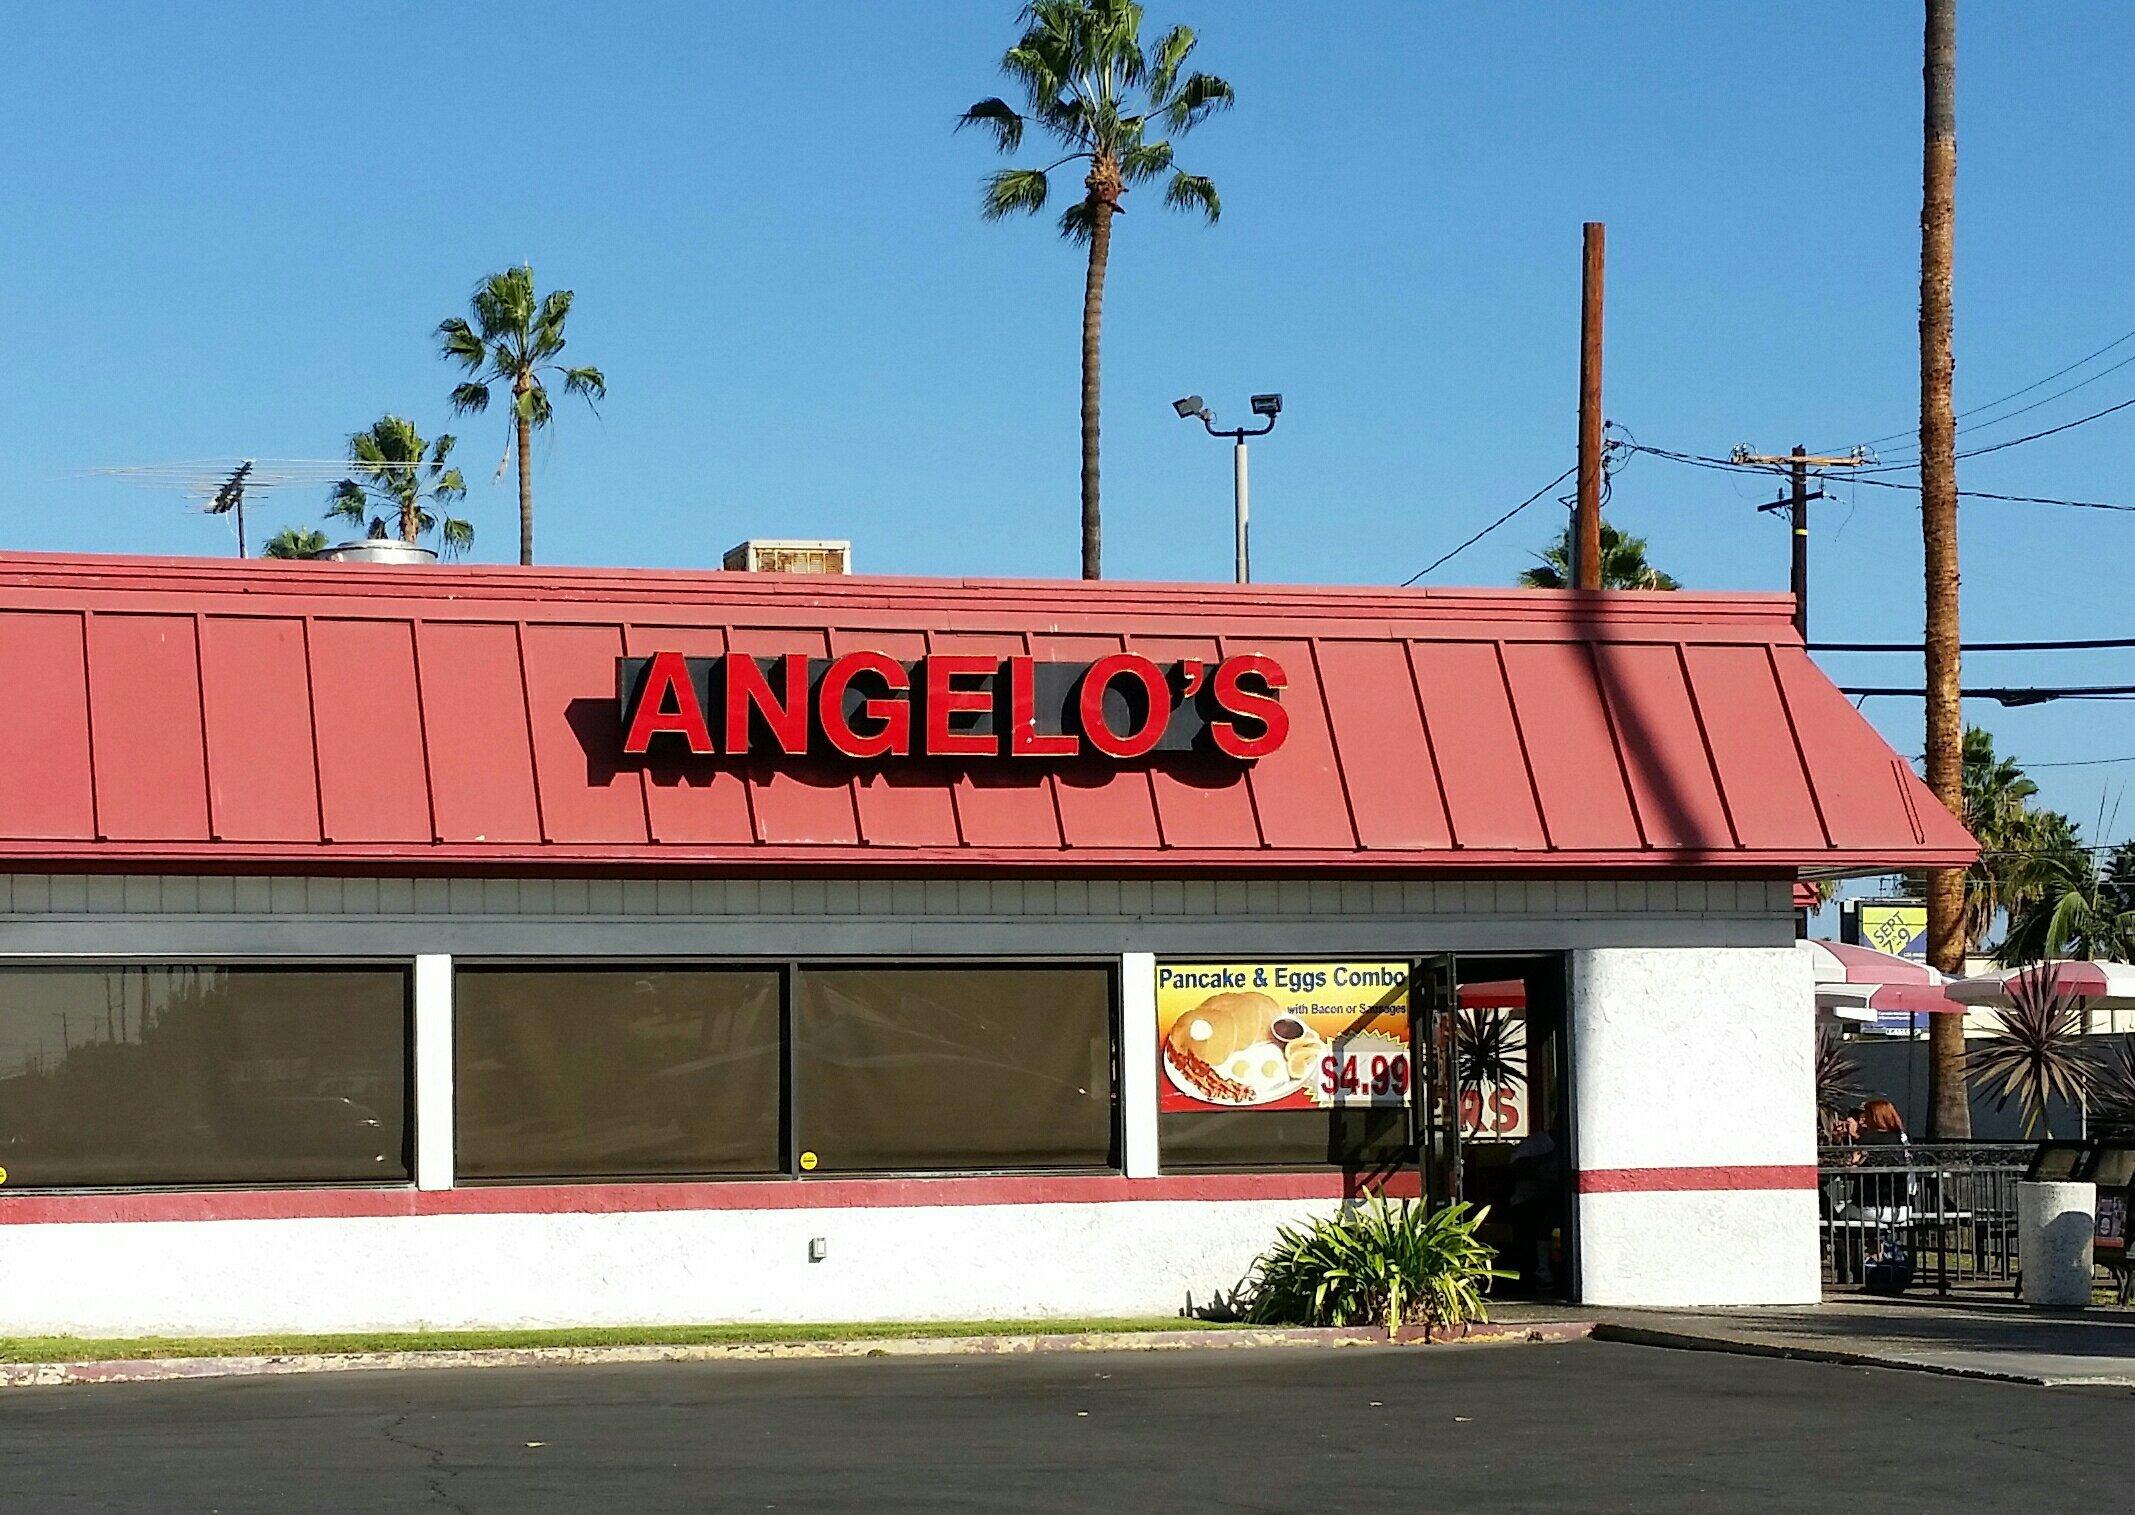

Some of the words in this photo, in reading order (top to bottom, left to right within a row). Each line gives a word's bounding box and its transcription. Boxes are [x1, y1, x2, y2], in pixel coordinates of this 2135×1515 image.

[623, 650, 1291, 758] ANGELO'S
[1873, 911, 1904, 944] SEPT
[1159, 968, 1246, 989] Pancake
[1253, 967, 1268, 988] &
[1274, 967, 1327, 993] Eggs
[1333, 966, 1407, 987] Combo
[1287, 1003, 1308, 1015] with
[1311, 1003, 1344, 1015] Bacon
[1346, 1005, 1357, 1014] or
[1359, 1003, 1407, 1016] Sausages
[1320, 1053, 1409, 1096] $4.99
